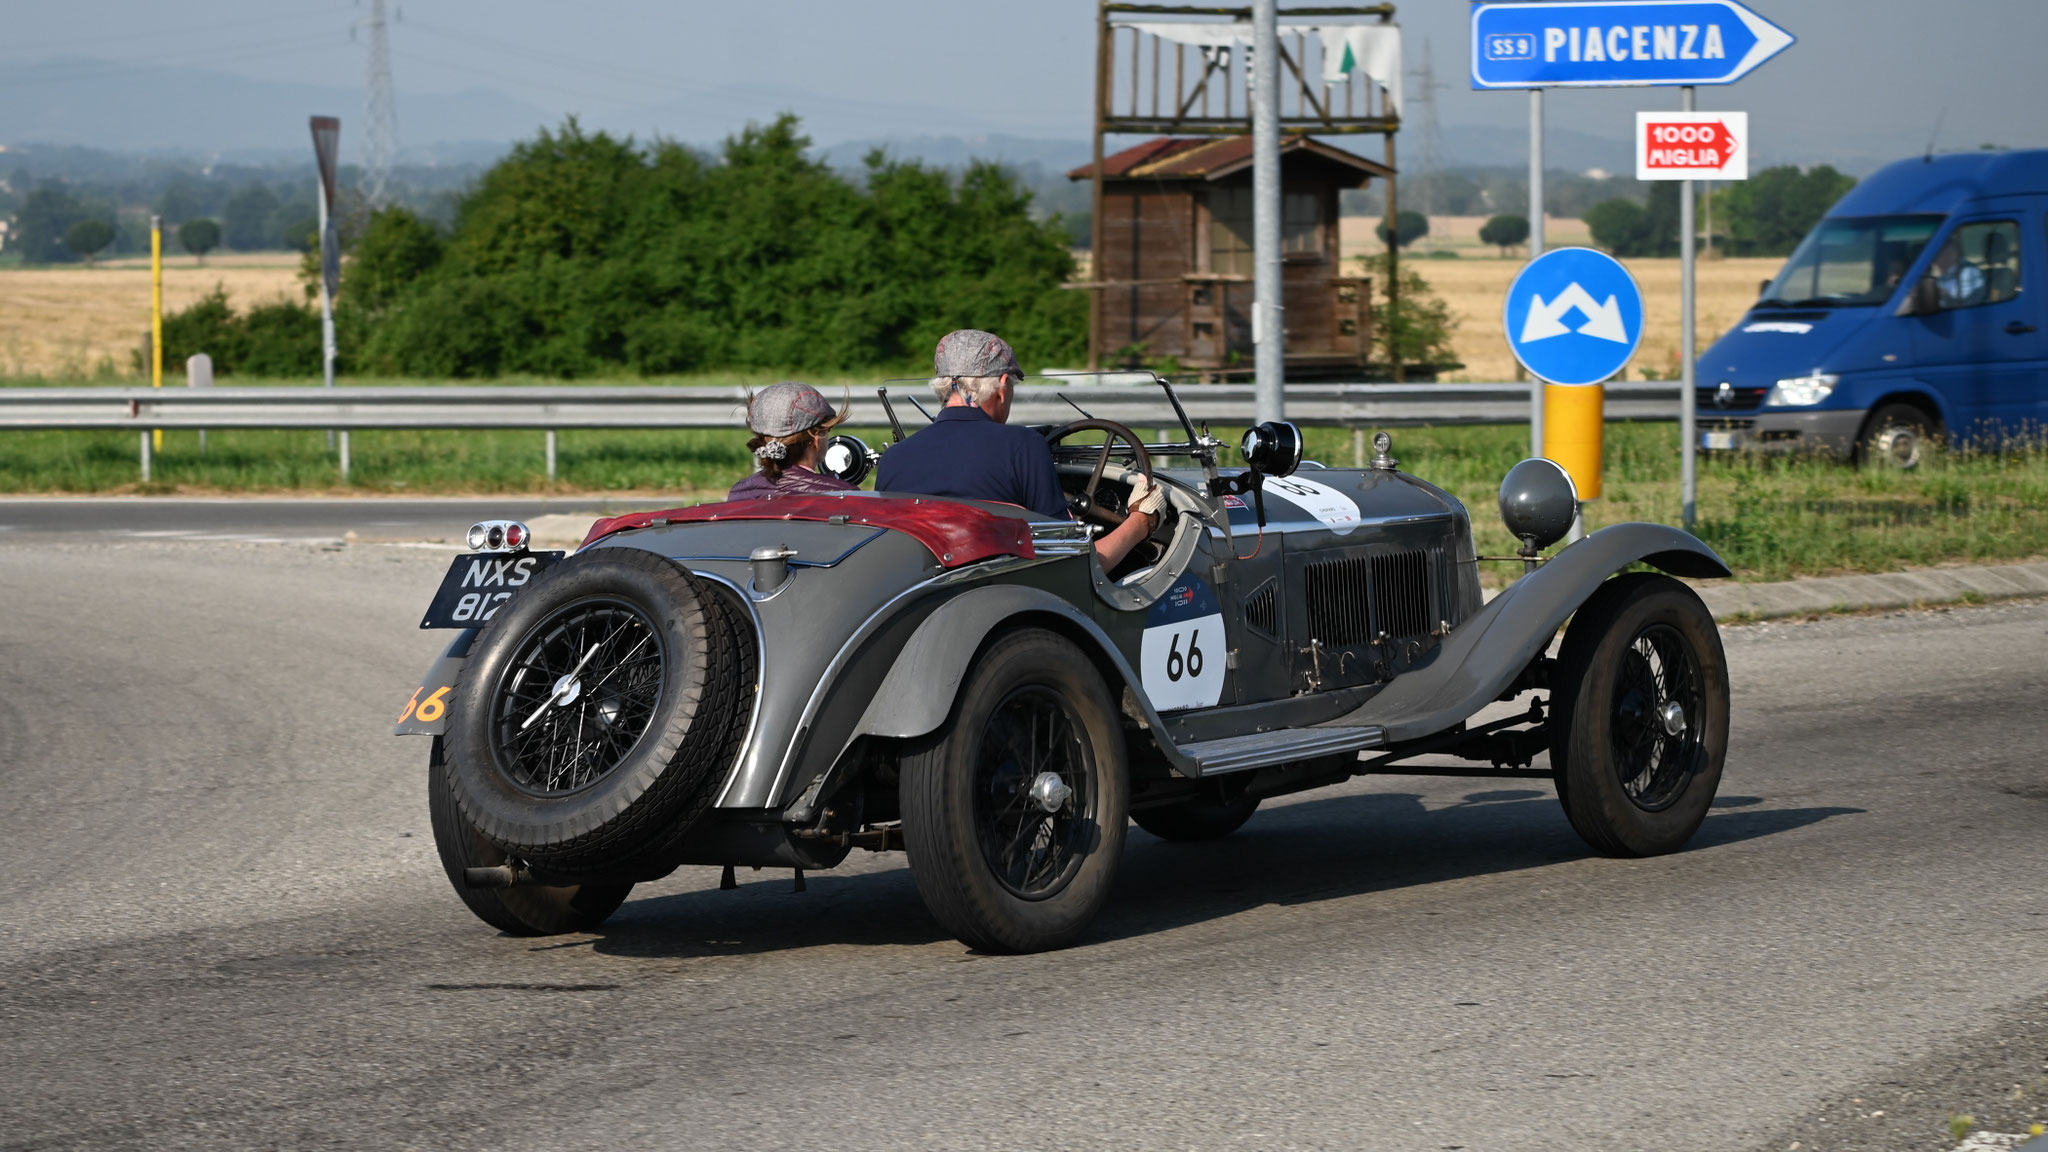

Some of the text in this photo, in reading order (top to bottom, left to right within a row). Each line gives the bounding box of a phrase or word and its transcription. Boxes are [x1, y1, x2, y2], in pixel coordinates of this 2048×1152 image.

[1493, 38, 1529, 55] SS 9
[1544, 24, 1726, 62] PIACENZA
[1652, 126, 1716, 143] 1000
[1648, 148, 1720, 166] MIGLIA
[460, 557, 537, 588] NXS
[1166, 629, 1204, 682] 66
[397, 686, 452, 724] 66
